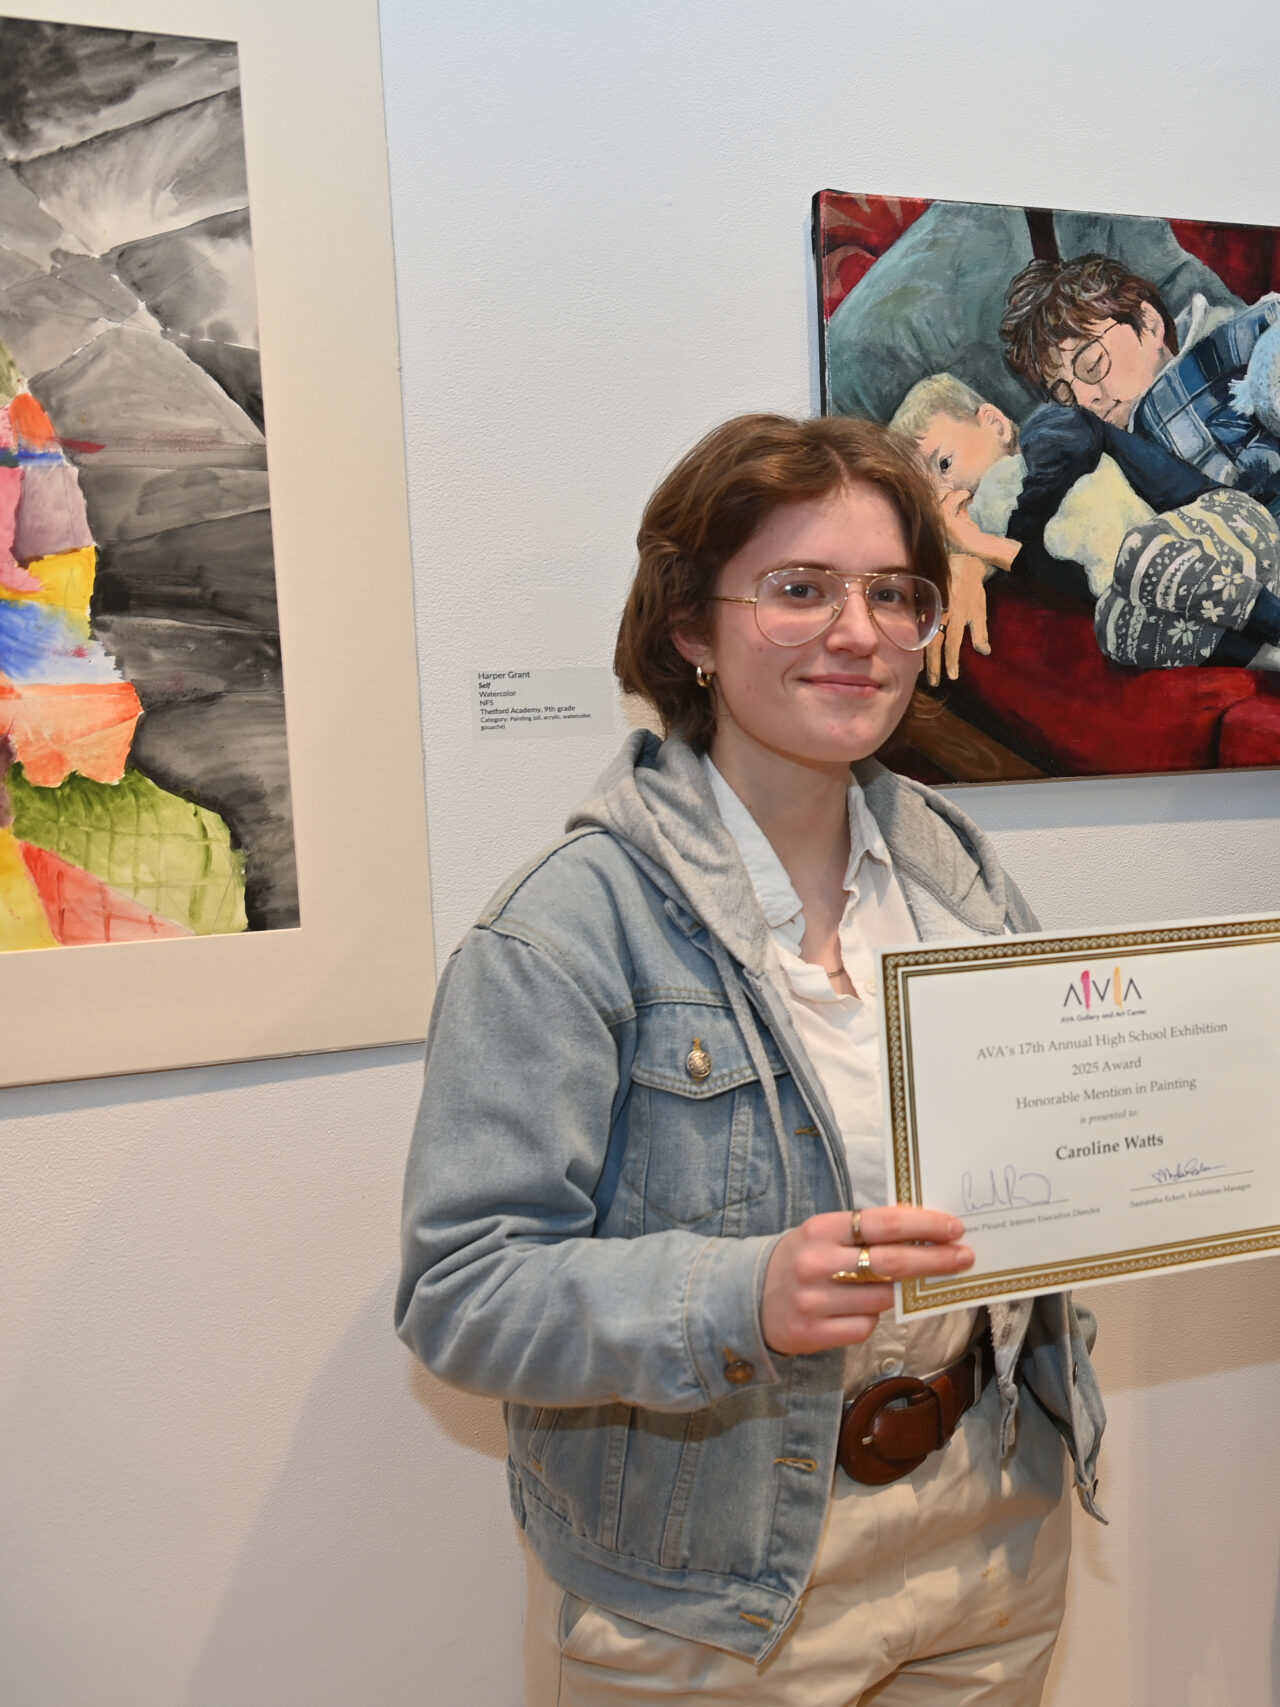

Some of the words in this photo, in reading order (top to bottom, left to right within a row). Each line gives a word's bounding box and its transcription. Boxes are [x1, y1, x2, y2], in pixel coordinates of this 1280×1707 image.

[478, 672, 506, 680] Harper
[507, 671, 531, 679] Grant
[479, 690, 517, 698] Watercolor
[511, 706, 543, 714] Academy,
[557, 705, 576, 713] grade
[480, 716, 509, 724] Category:
[976, 1044, 1015, 1060] AVA's
[1019, 1042, 1045, 1056] 17th
[1048, 1035, 1092, 1052] Annual
[1096, 1032, 1126, 1049] High
[1128, 1028, 1167, 1044] School
[1170, 1022, 1228, 1039] Exhibition
[1071, 1061, 1099, 1076] 2025
[1102, 1056, 1142, 1072] Award
[1016, 1090, 1081, 1110] Honorable
[1083, 1085, 1133, 1101] Mention
[1135, 1082, 1147, 1094] in
[1149, 1076, 1198, 1094] Painting
[1087, 1108, 1127, 1125] presented
[1056, 1140, 1120, 1161] Caroline
[1123, 1133, 1164, 1150] Watts
